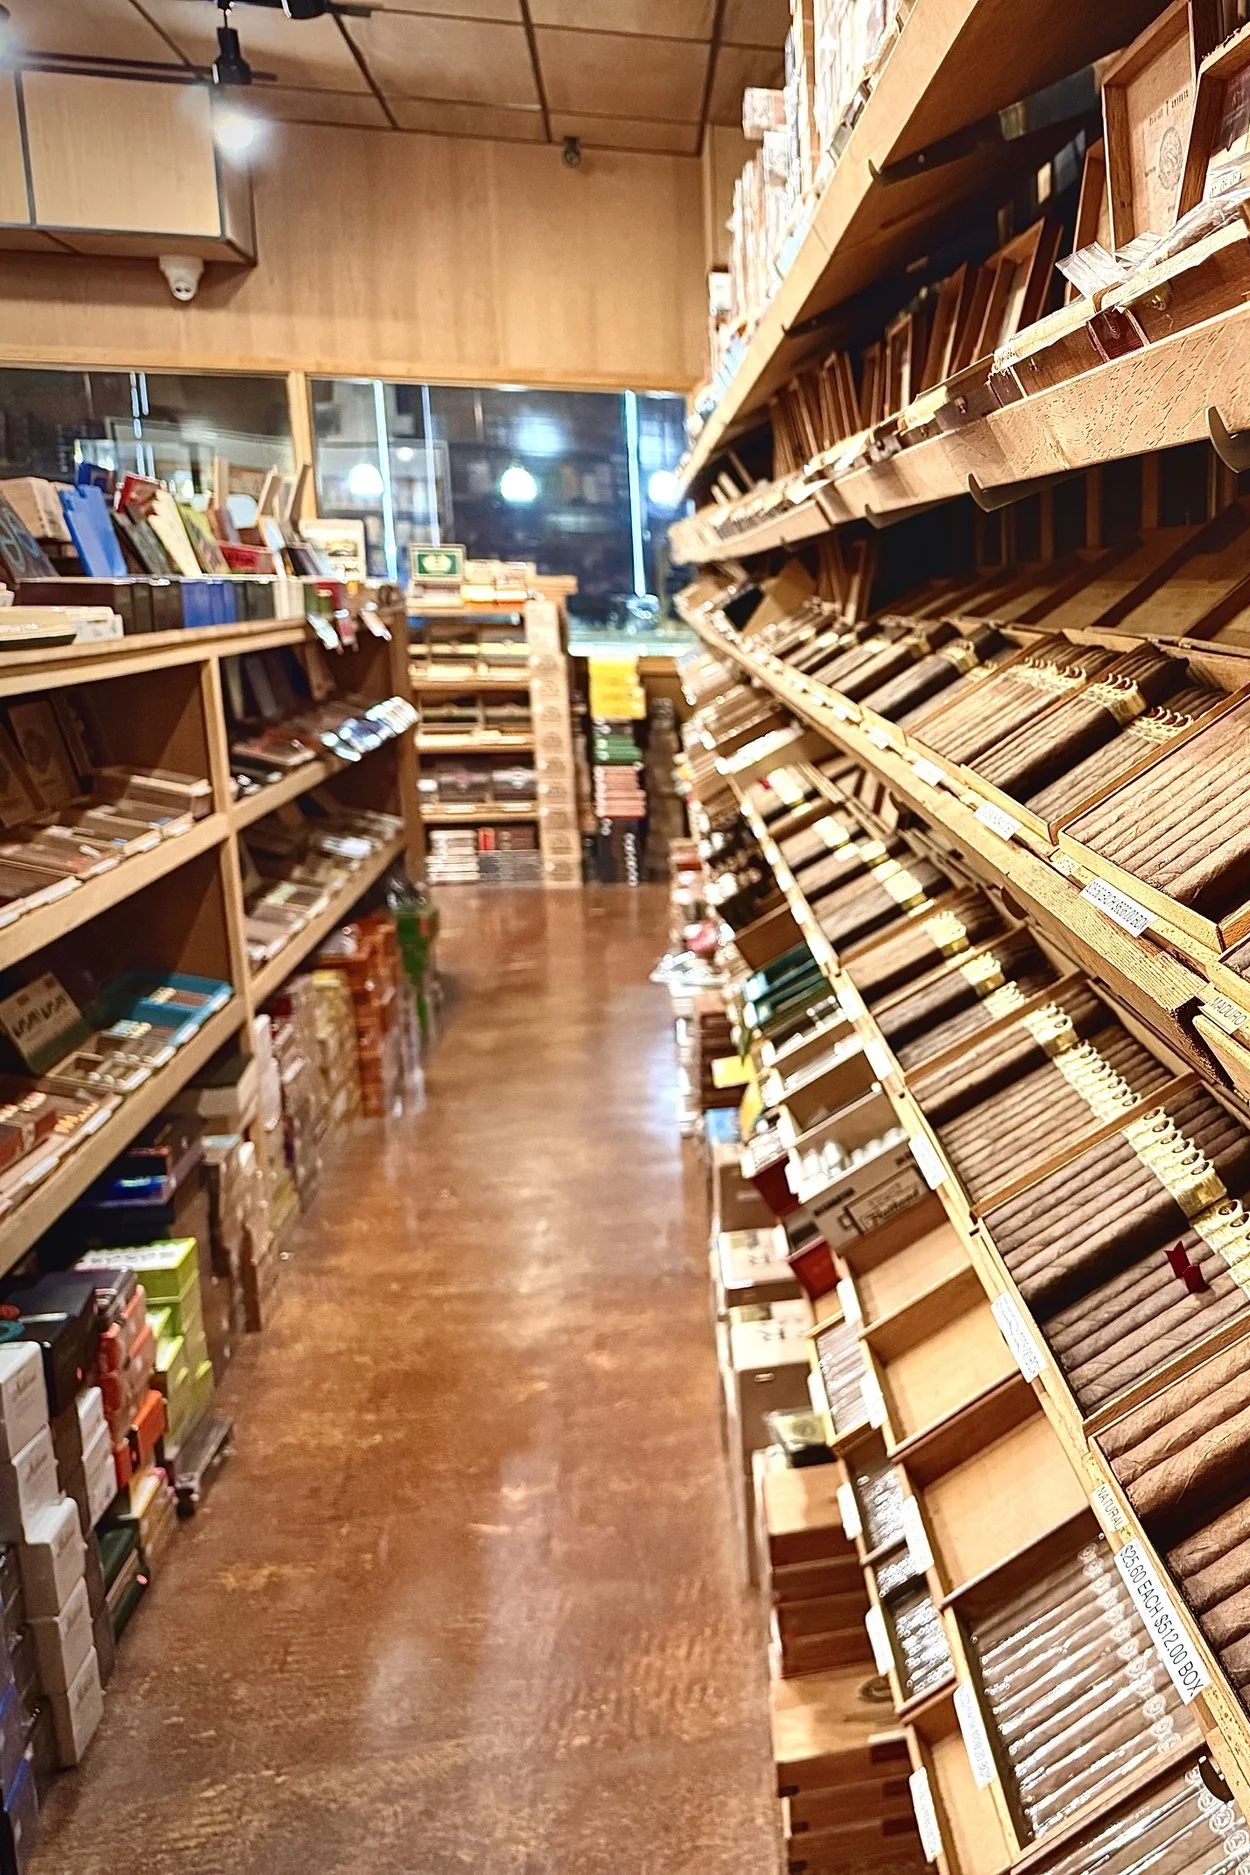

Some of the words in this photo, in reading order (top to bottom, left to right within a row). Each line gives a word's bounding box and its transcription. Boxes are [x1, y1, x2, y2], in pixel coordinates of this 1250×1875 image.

[1211, 996, 1247, 1026] MADURO
[1097, 1486, 1123, 1530] NATURAL
[1120, 1545, 1147, 1584] $25.60
[1137, 1579, 1164, 1618] EACH
[1154, 1613, 1187, 1665] $512.00
[1178, 1661, 1204, 1697] BOX
